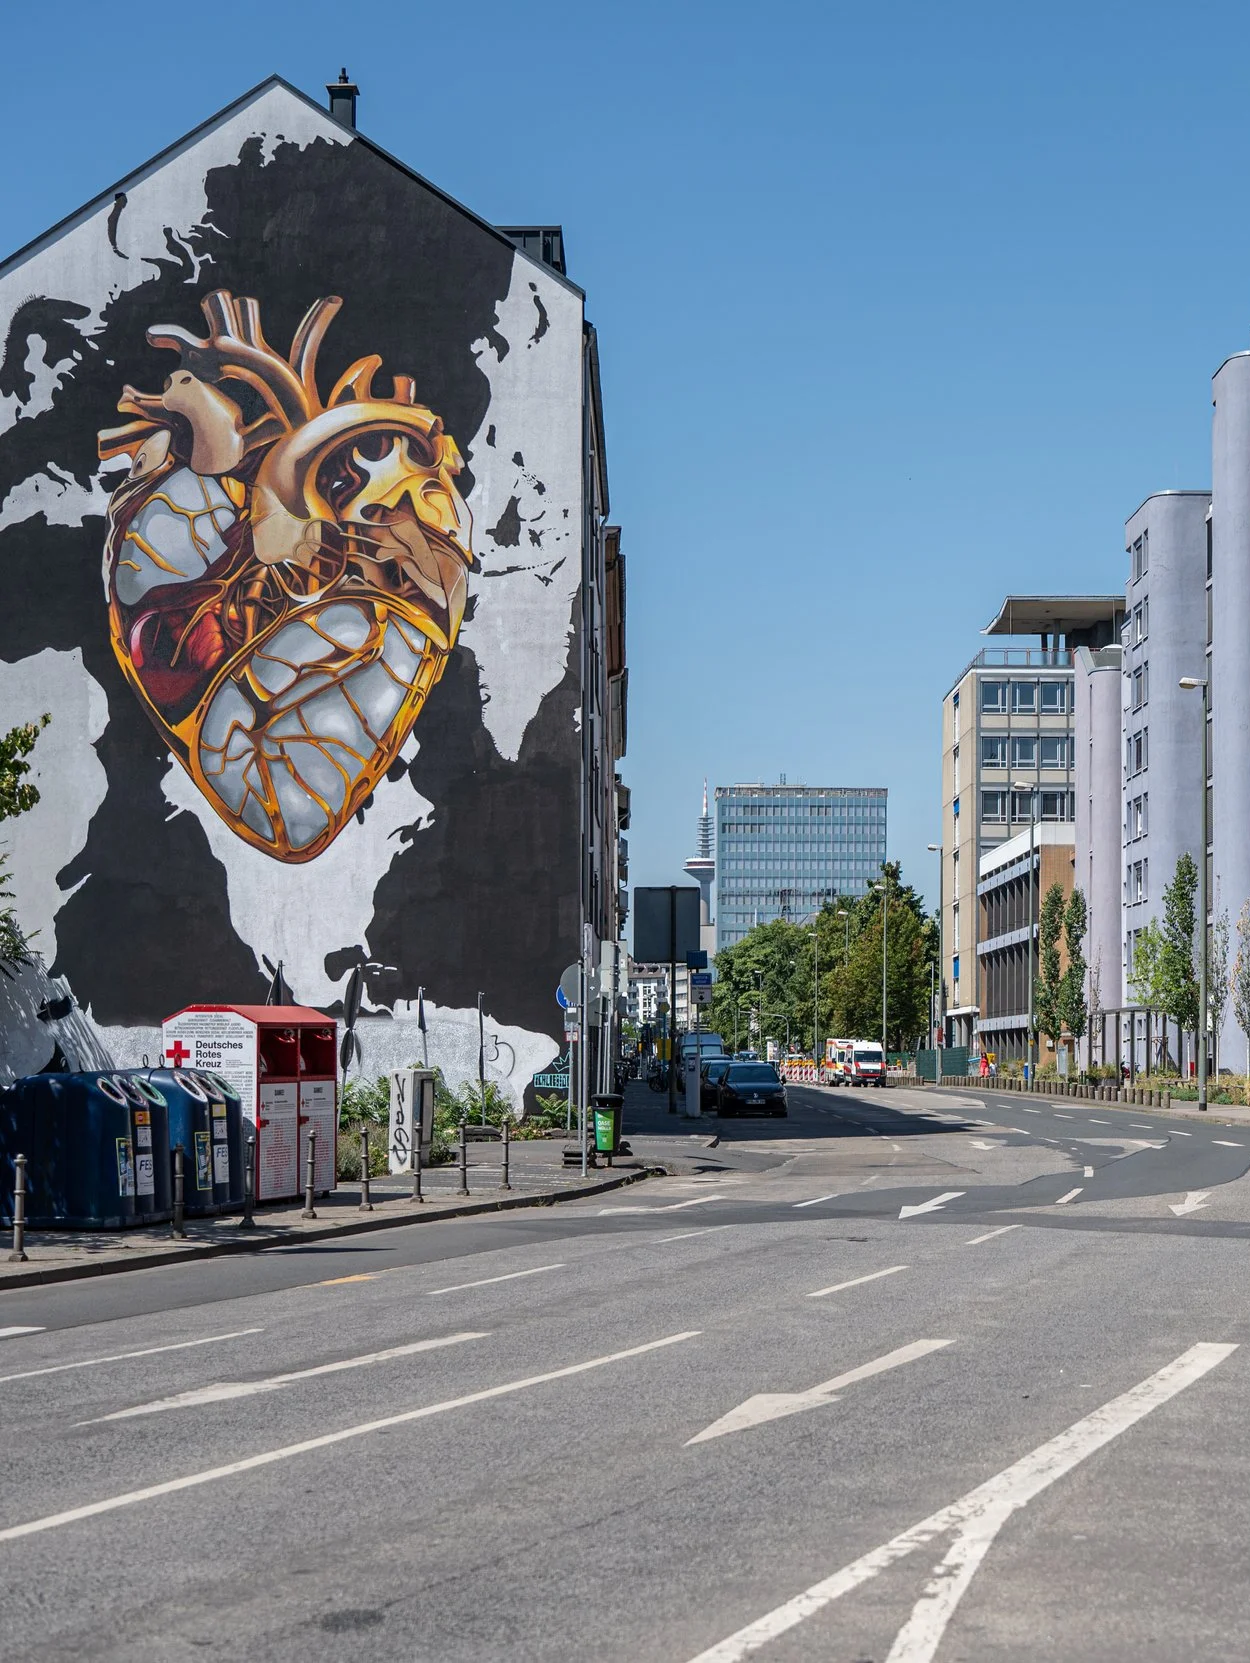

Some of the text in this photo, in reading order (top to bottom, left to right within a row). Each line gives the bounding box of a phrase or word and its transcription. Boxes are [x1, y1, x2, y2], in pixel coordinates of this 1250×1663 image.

[195, 1040, 243, 1049] Deutsches
[195, 1050, 222, 1058] Rotes
[195, 1060, 222, 1068] Kreuz
